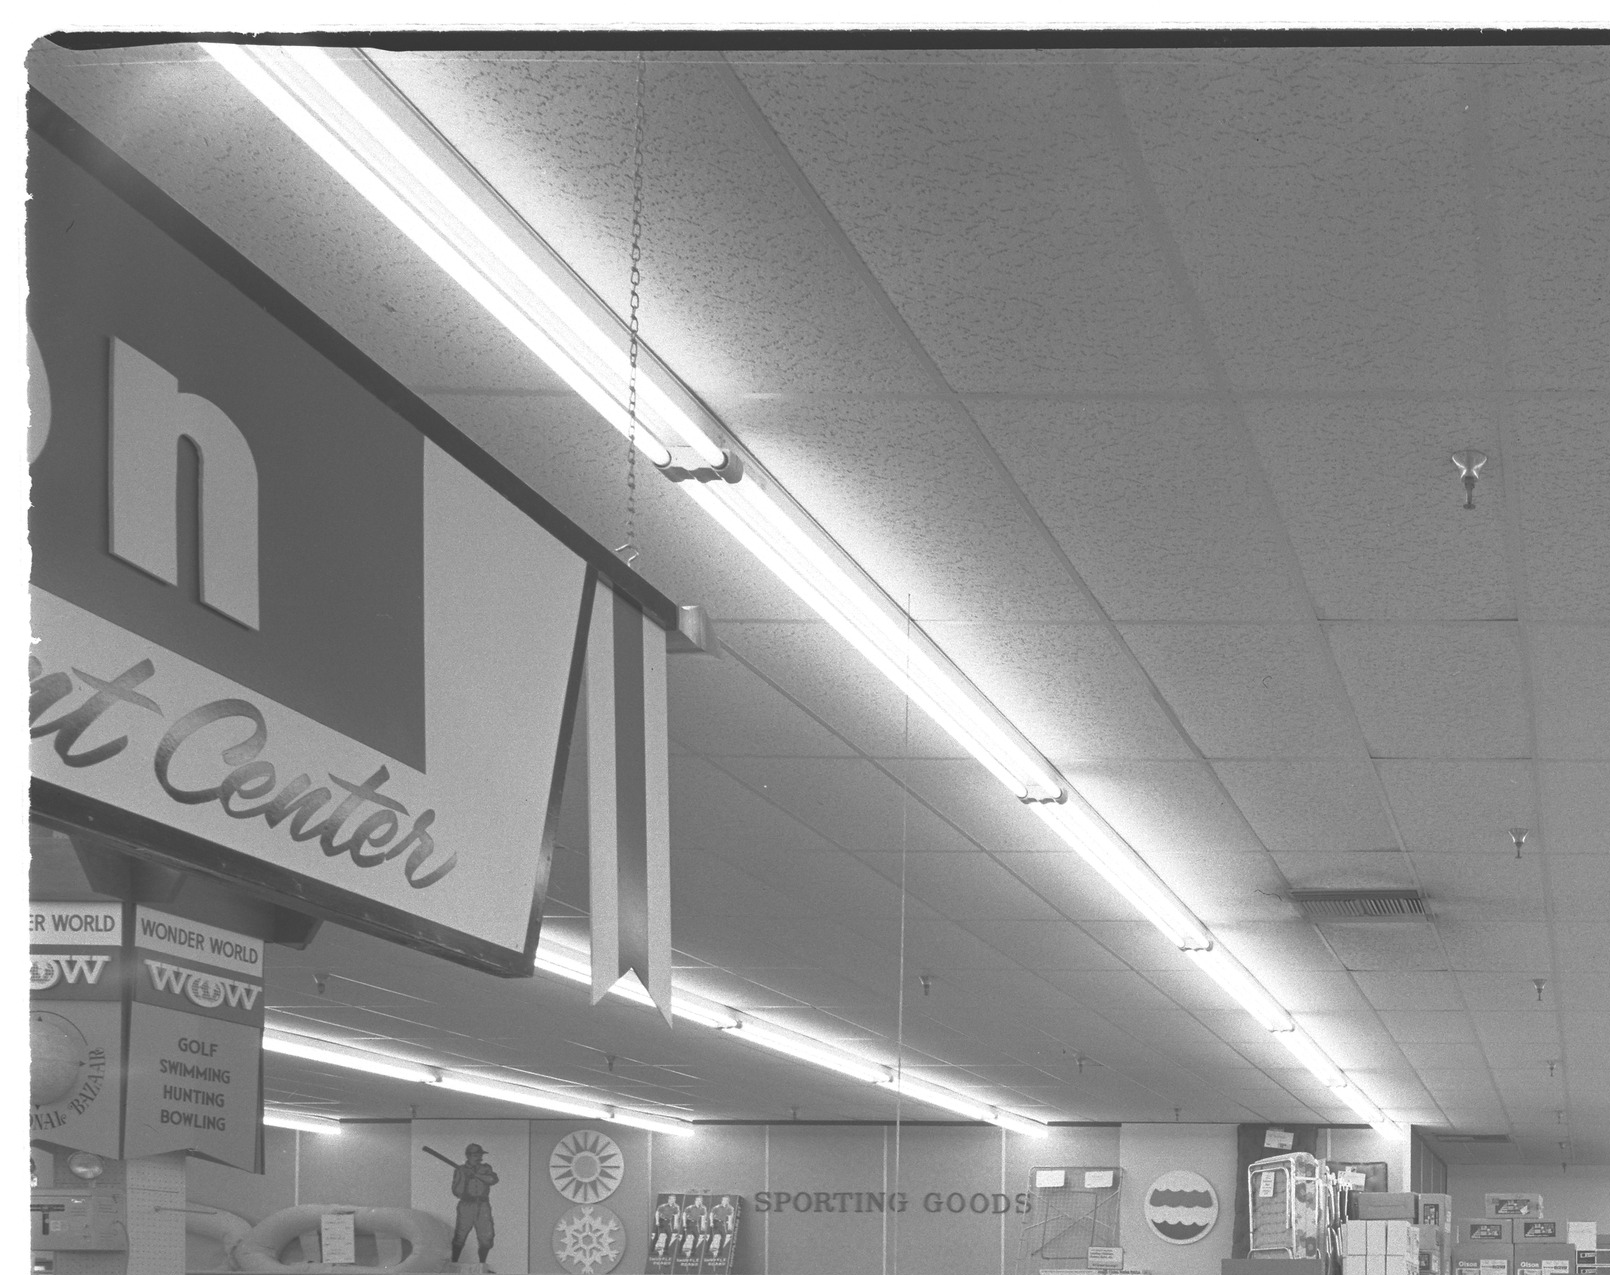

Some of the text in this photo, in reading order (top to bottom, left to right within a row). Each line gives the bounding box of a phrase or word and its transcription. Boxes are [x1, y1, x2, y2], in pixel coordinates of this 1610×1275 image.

[153, 698, 457, 889] Center
[50, 914, 116, 933] WORLD
[141, 916, 259, 966] WONDER WORLD
[178, 1037, 218, 1058] GOLF
[159, 1058, 231, 1085] SWIMMING
[163, 1084, 225, 1108] HUNTING
[160, 1109, 226, 1132] BOWLING
[754, 1191, 1033, 1214] SPORTING GOODS
